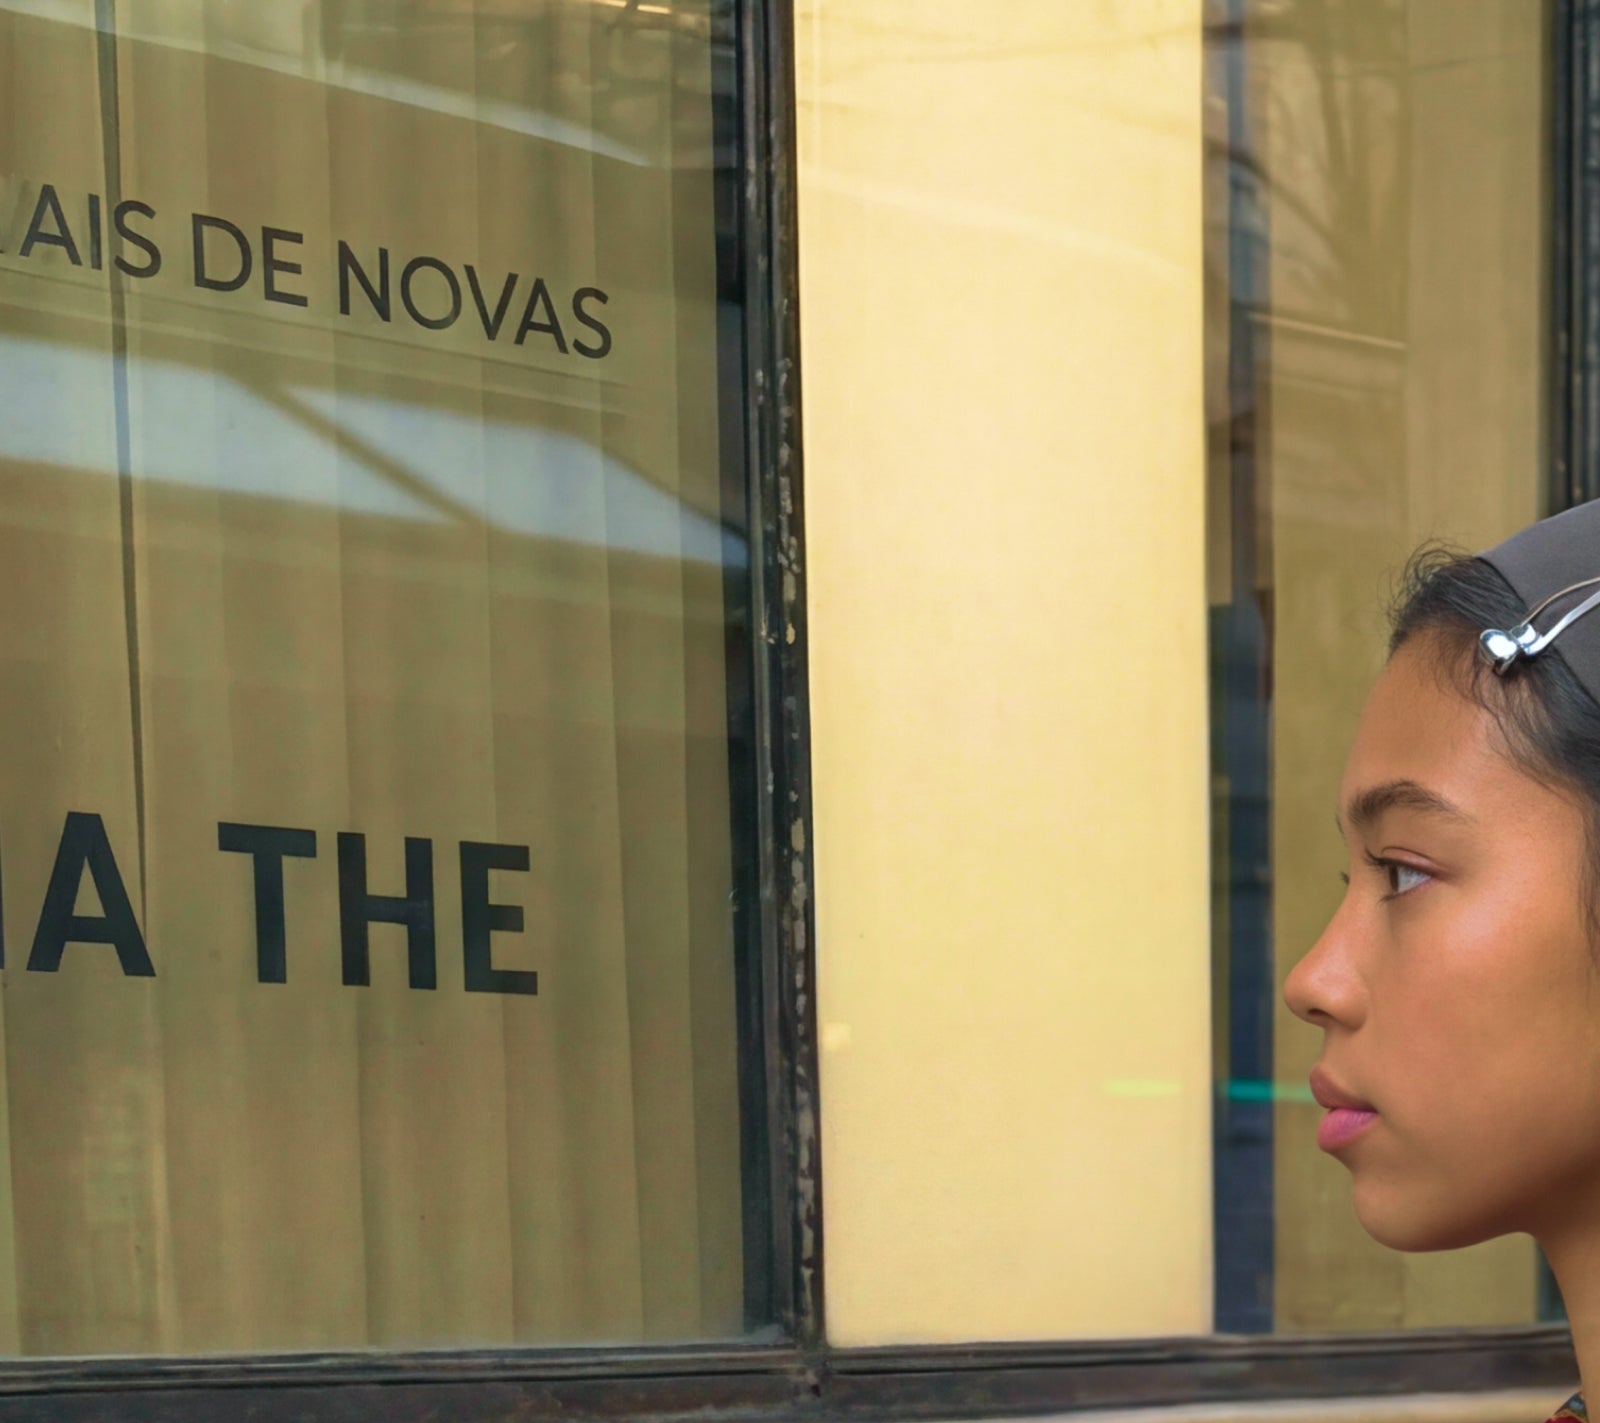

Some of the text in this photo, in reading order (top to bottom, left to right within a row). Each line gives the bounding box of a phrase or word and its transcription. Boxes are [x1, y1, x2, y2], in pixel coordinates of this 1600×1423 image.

[0, 184, 612, 359] AIS DE NOVAS
[0, 811, 539, 996] A THE
